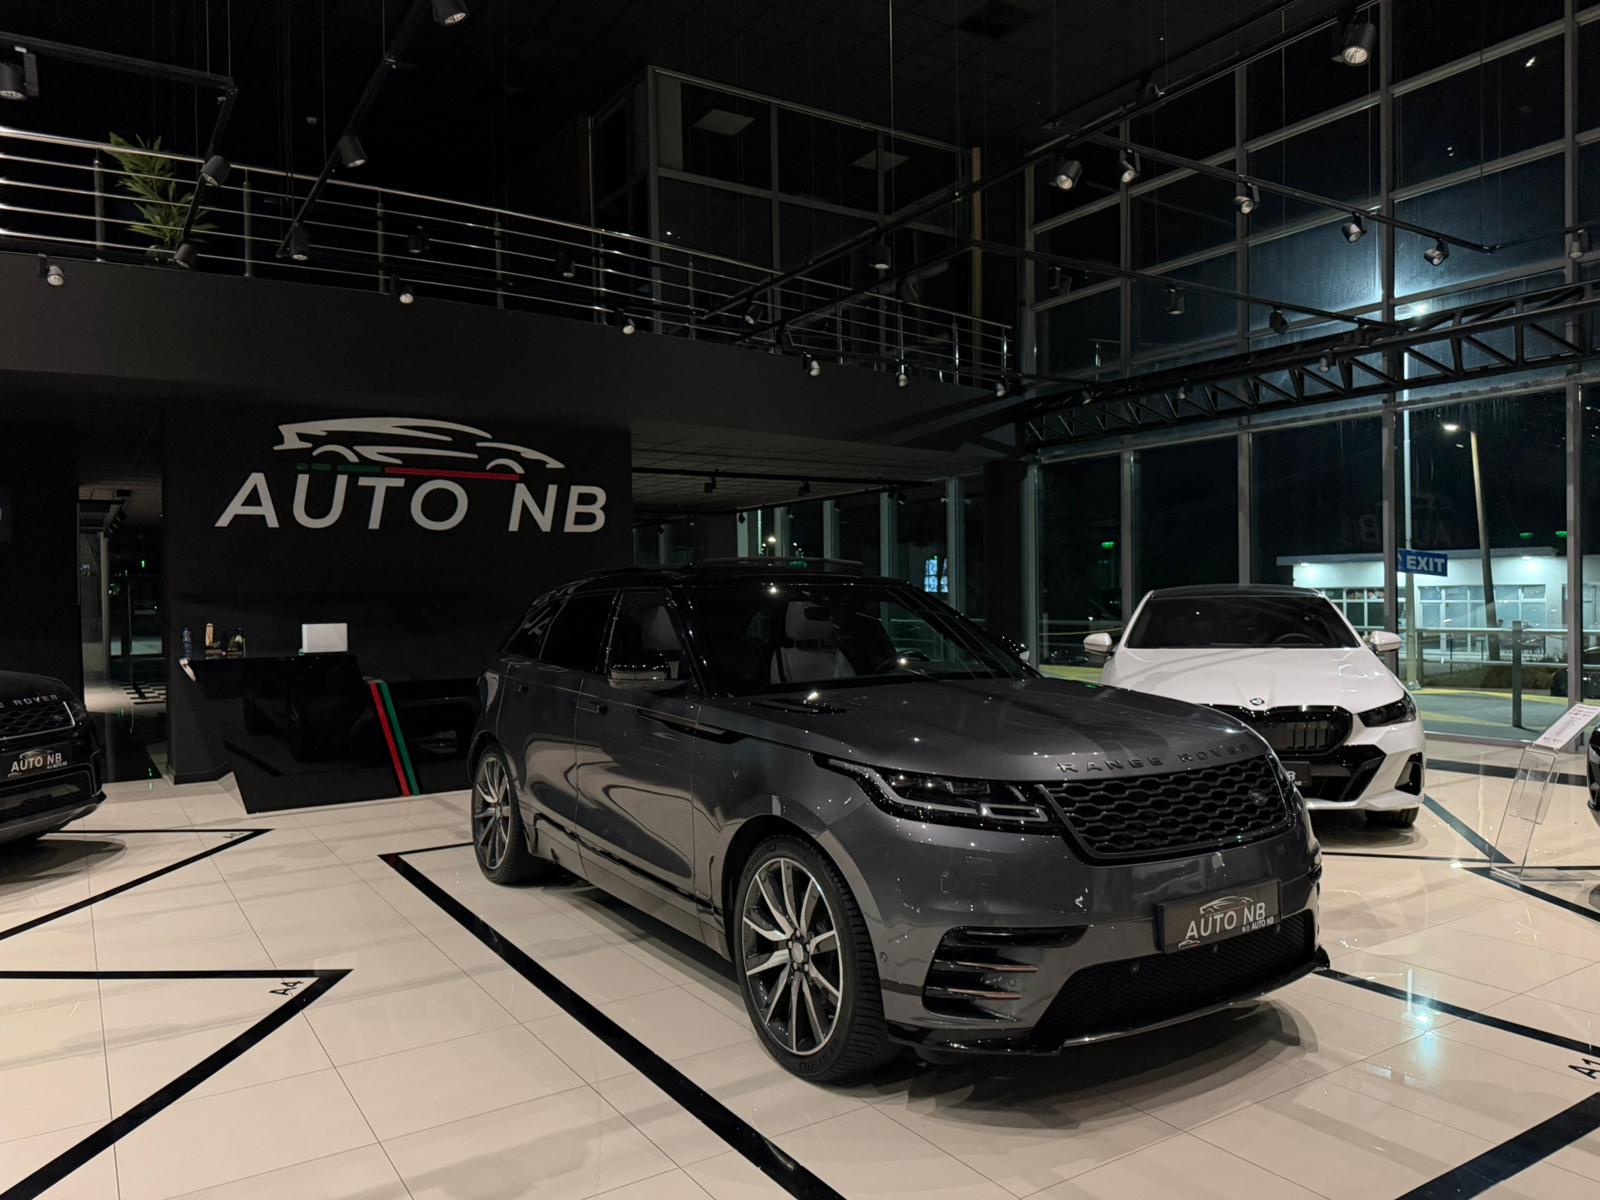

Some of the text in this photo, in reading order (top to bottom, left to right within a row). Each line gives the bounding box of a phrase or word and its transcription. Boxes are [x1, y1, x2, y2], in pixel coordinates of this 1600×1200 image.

[213, 471, 608, 534] AUTO NB
[1405, 554, 1446, 573] EXIT
[10, 758, 43, 773] AUTO
[46, 753, 63, 765] NB
[1057, 743, 1250, 774] RANGE ROVER
[1185, 902, 1266, 940] AUTO NB
[269, 981, 303, 995] A4
